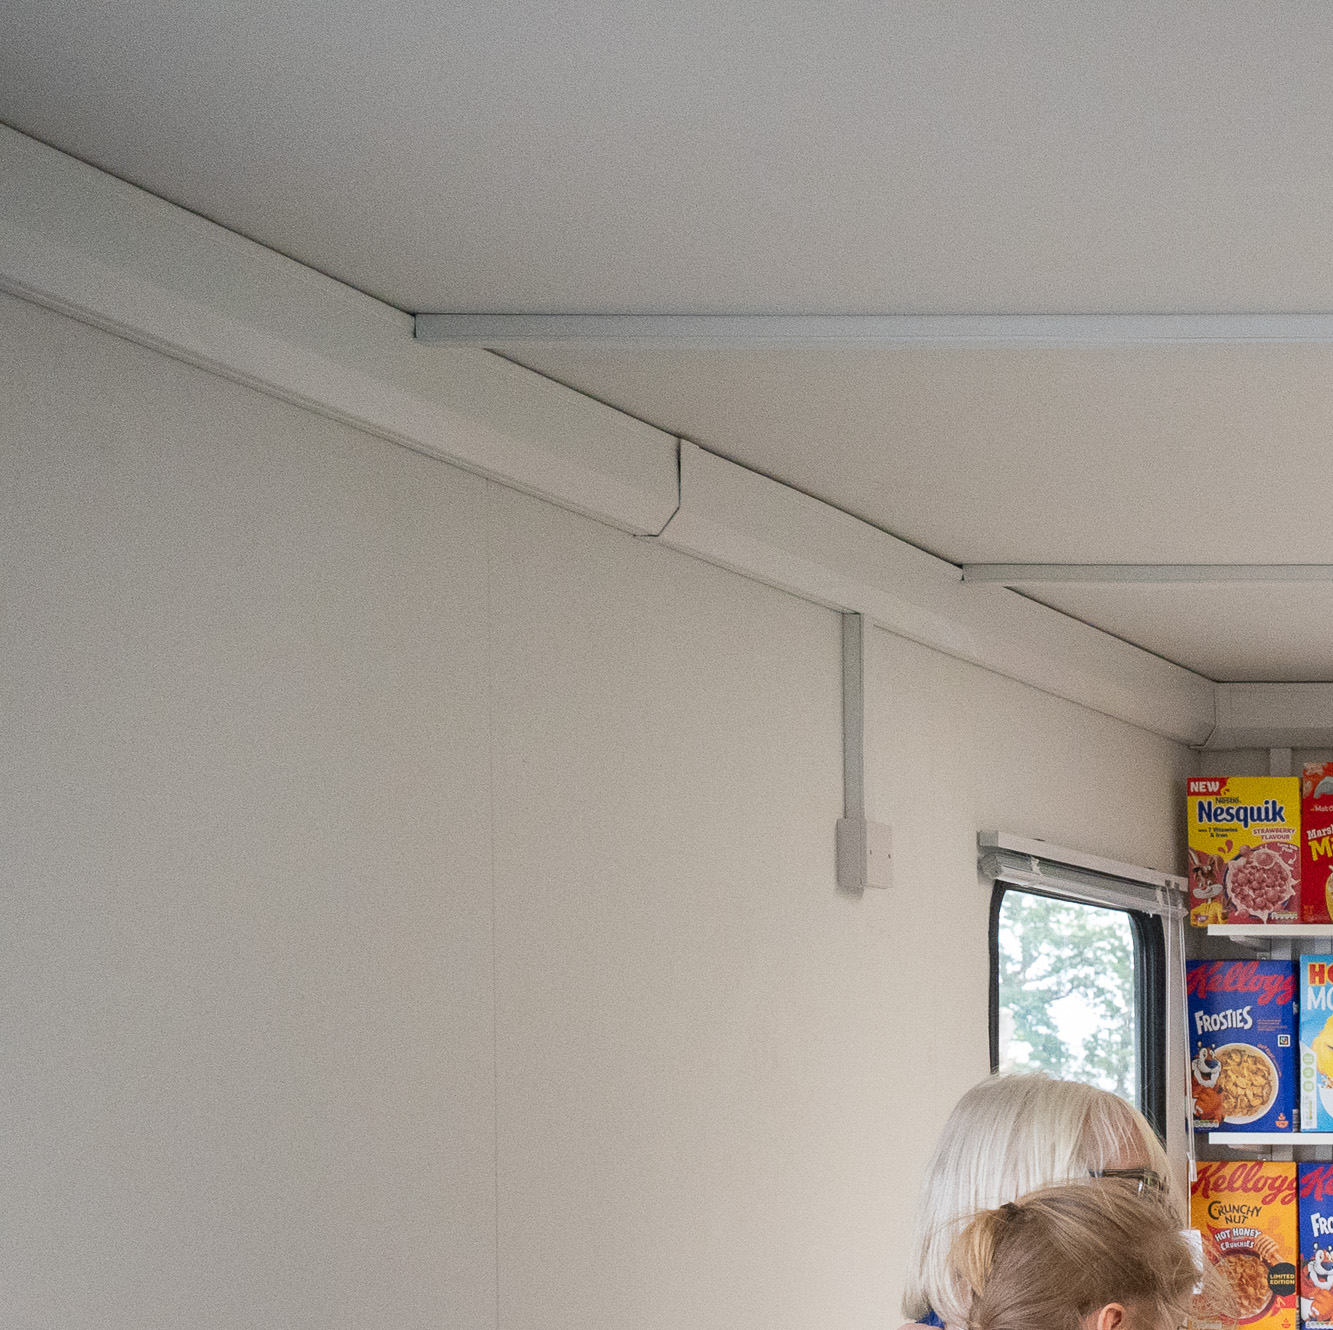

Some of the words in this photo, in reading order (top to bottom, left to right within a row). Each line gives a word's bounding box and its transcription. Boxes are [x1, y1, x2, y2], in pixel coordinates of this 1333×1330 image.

[1190, 781, 1220, 793] NEW
[1198, 800, 1286, 828] Nesquik
[1252, 828, 1296, 836] STRAWBERRY
[1194, 1005, 1253, 1036] FROSTIES
[1207, 1201, 1262, 1220] CRUNCHY
[1225, 1215, 1248, 1225] NUT
[1215, 1229, 1231, 1242] HOT
[1232, 1227, 1262, 1239] HONEY
[1220, 1240, 1255, 1250] CRUNCHIES
